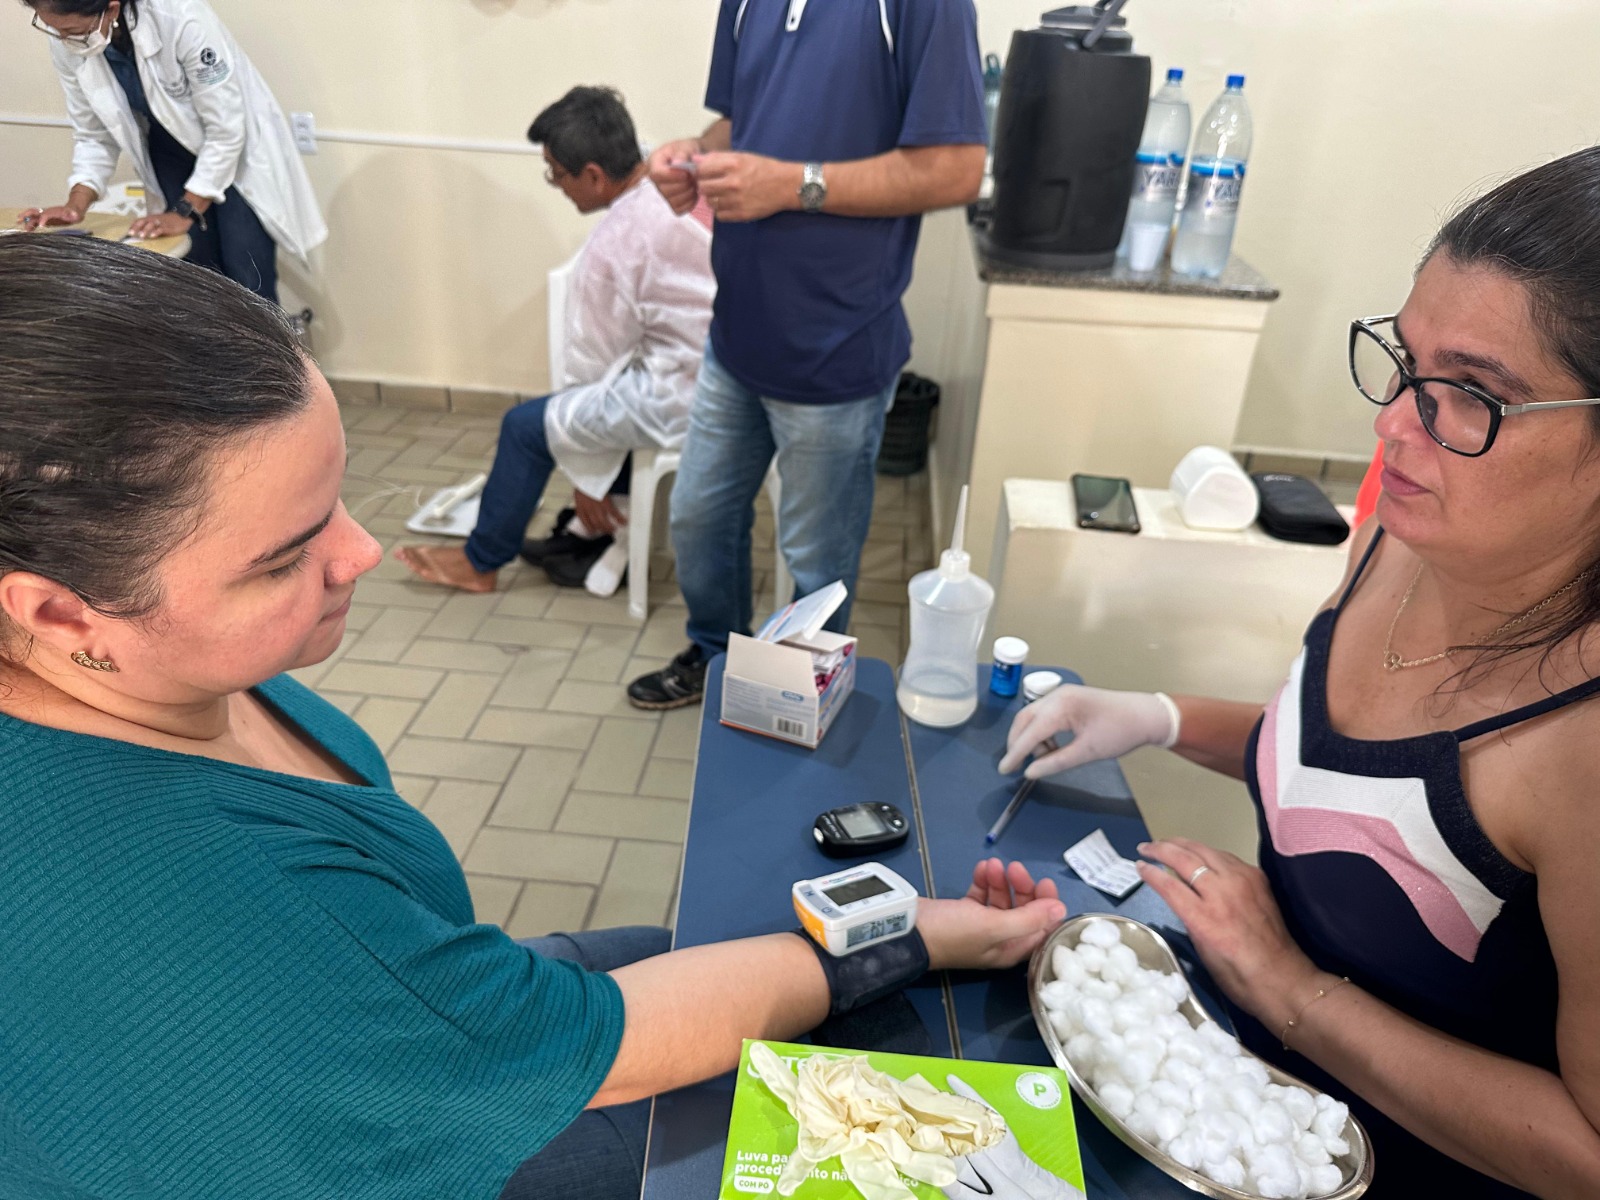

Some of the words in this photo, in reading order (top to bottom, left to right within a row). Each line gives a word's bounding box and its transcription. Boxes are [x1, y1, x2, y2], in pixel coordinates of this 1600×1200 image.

[1033, 1083, 1046, 1096] P
[737, 1150, 768, 1162] Luva
[771, 1154, 790, 1165] pa
[735, 1163, 829, 1179] procednto
[831, 1168, 849, 1181] nã
[739, 1180, 756, 1188] COM
[758, 1181, 769, 1189] PÓ
